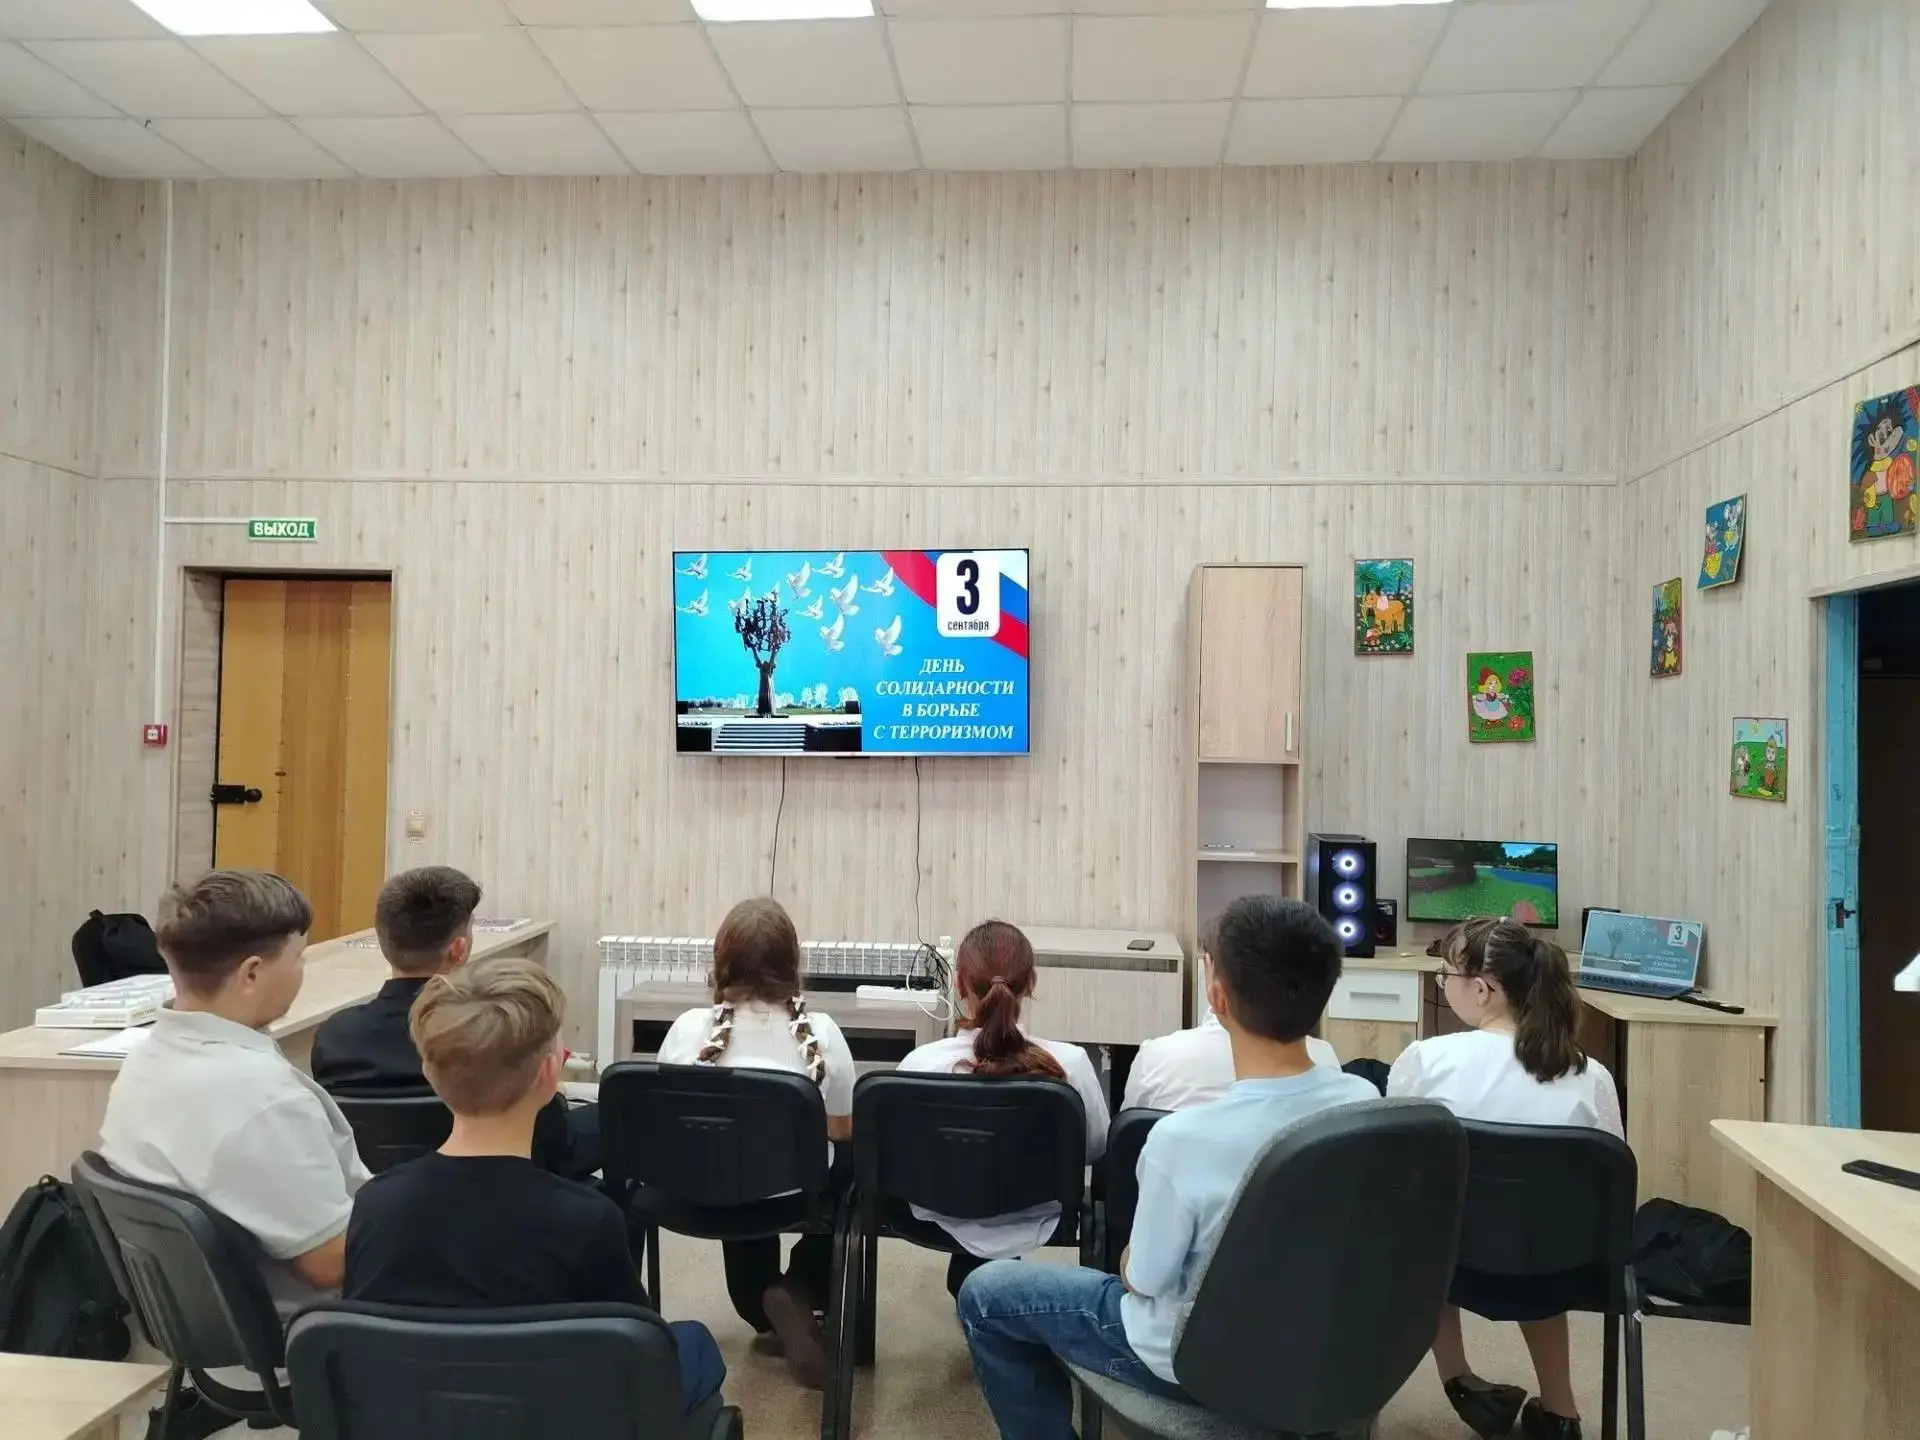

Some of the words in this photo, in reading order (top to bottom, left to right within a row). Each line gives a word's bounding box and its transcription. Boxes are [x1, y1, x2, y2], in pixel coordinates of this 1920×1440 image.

[254, 522, 309, 537] ВЫХОД
[956, 559, 980, 615] 3
[947, 618, 989, 632] сентября
[919, 658, 965, 675] ДЕНЬ
[876, 680, 1015, 697] СОЛИДАРНОСТИ
[902, 703, 913, 717] В
[916, 703, 980, 717] БОРЬБЕ
[873, 726, 886, 740] С
[890, 725, 1014, 740] ТЕРРОРИЗМОМ
[1674, 926, 1683, 940] 3
